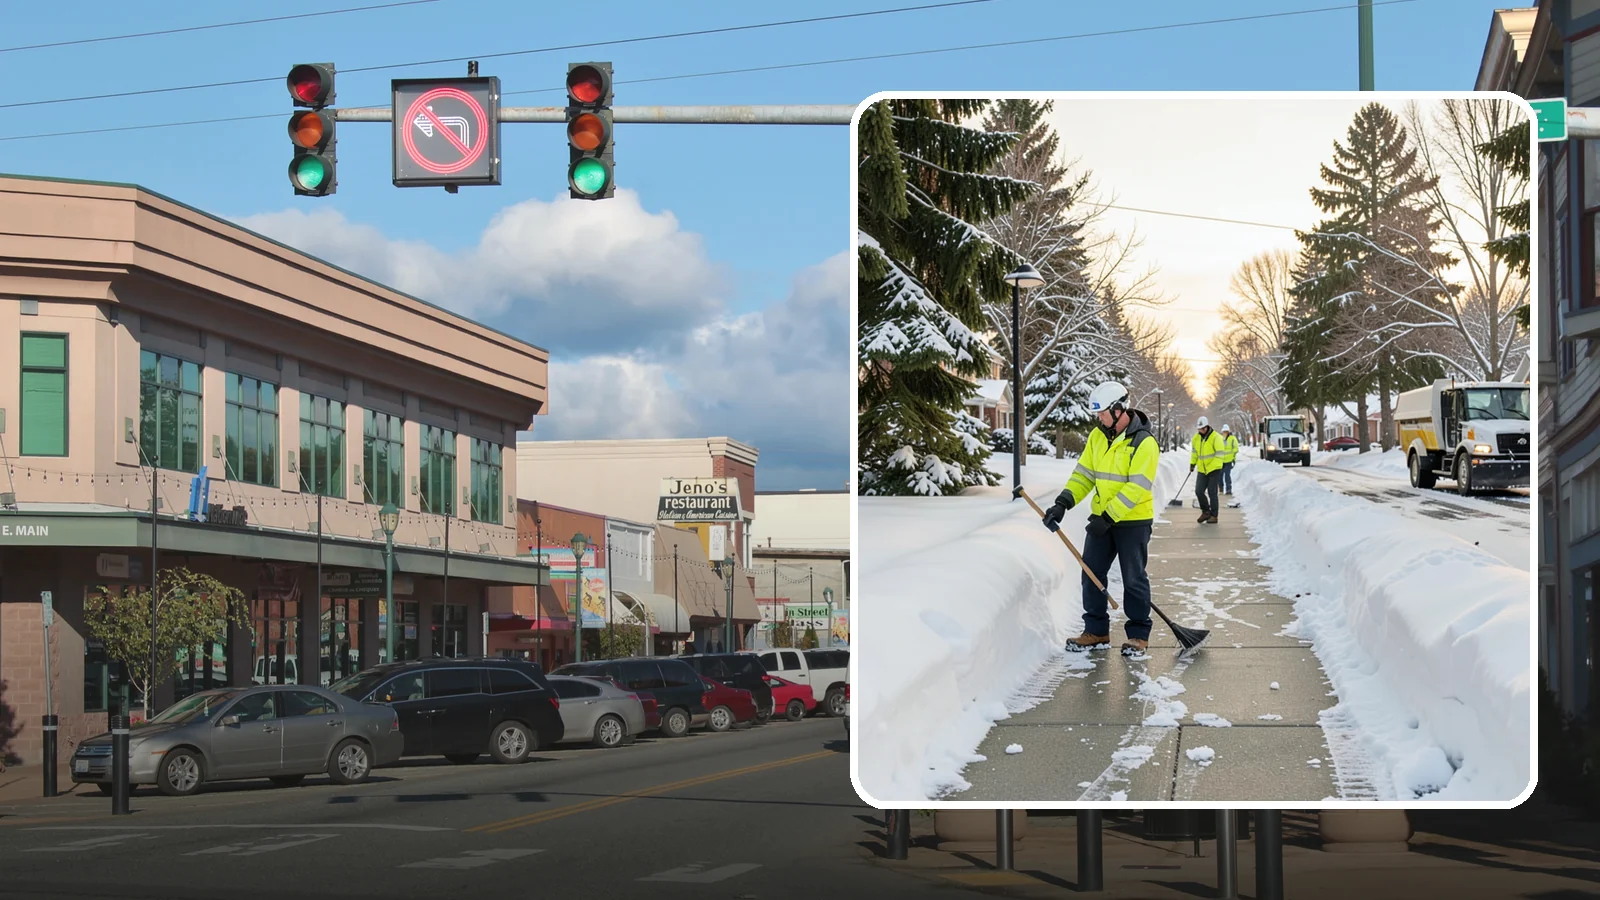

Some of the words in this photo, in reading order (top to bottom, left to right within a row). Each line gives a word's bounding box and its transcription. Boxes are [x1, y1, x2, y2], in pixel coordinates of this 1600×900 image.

[669, 480, 728, 495] Jeno's
[665, 496, 731, 509] restaurant
[658, 509, 682, 520] Italian
[685, 509, 714, 519] American
[714, 509, 738, 519] Cuisine
[2, 525, 13, 536] E.
[15, 525, 49, 536] MAIN
[797, 607, 829, 617] Street
